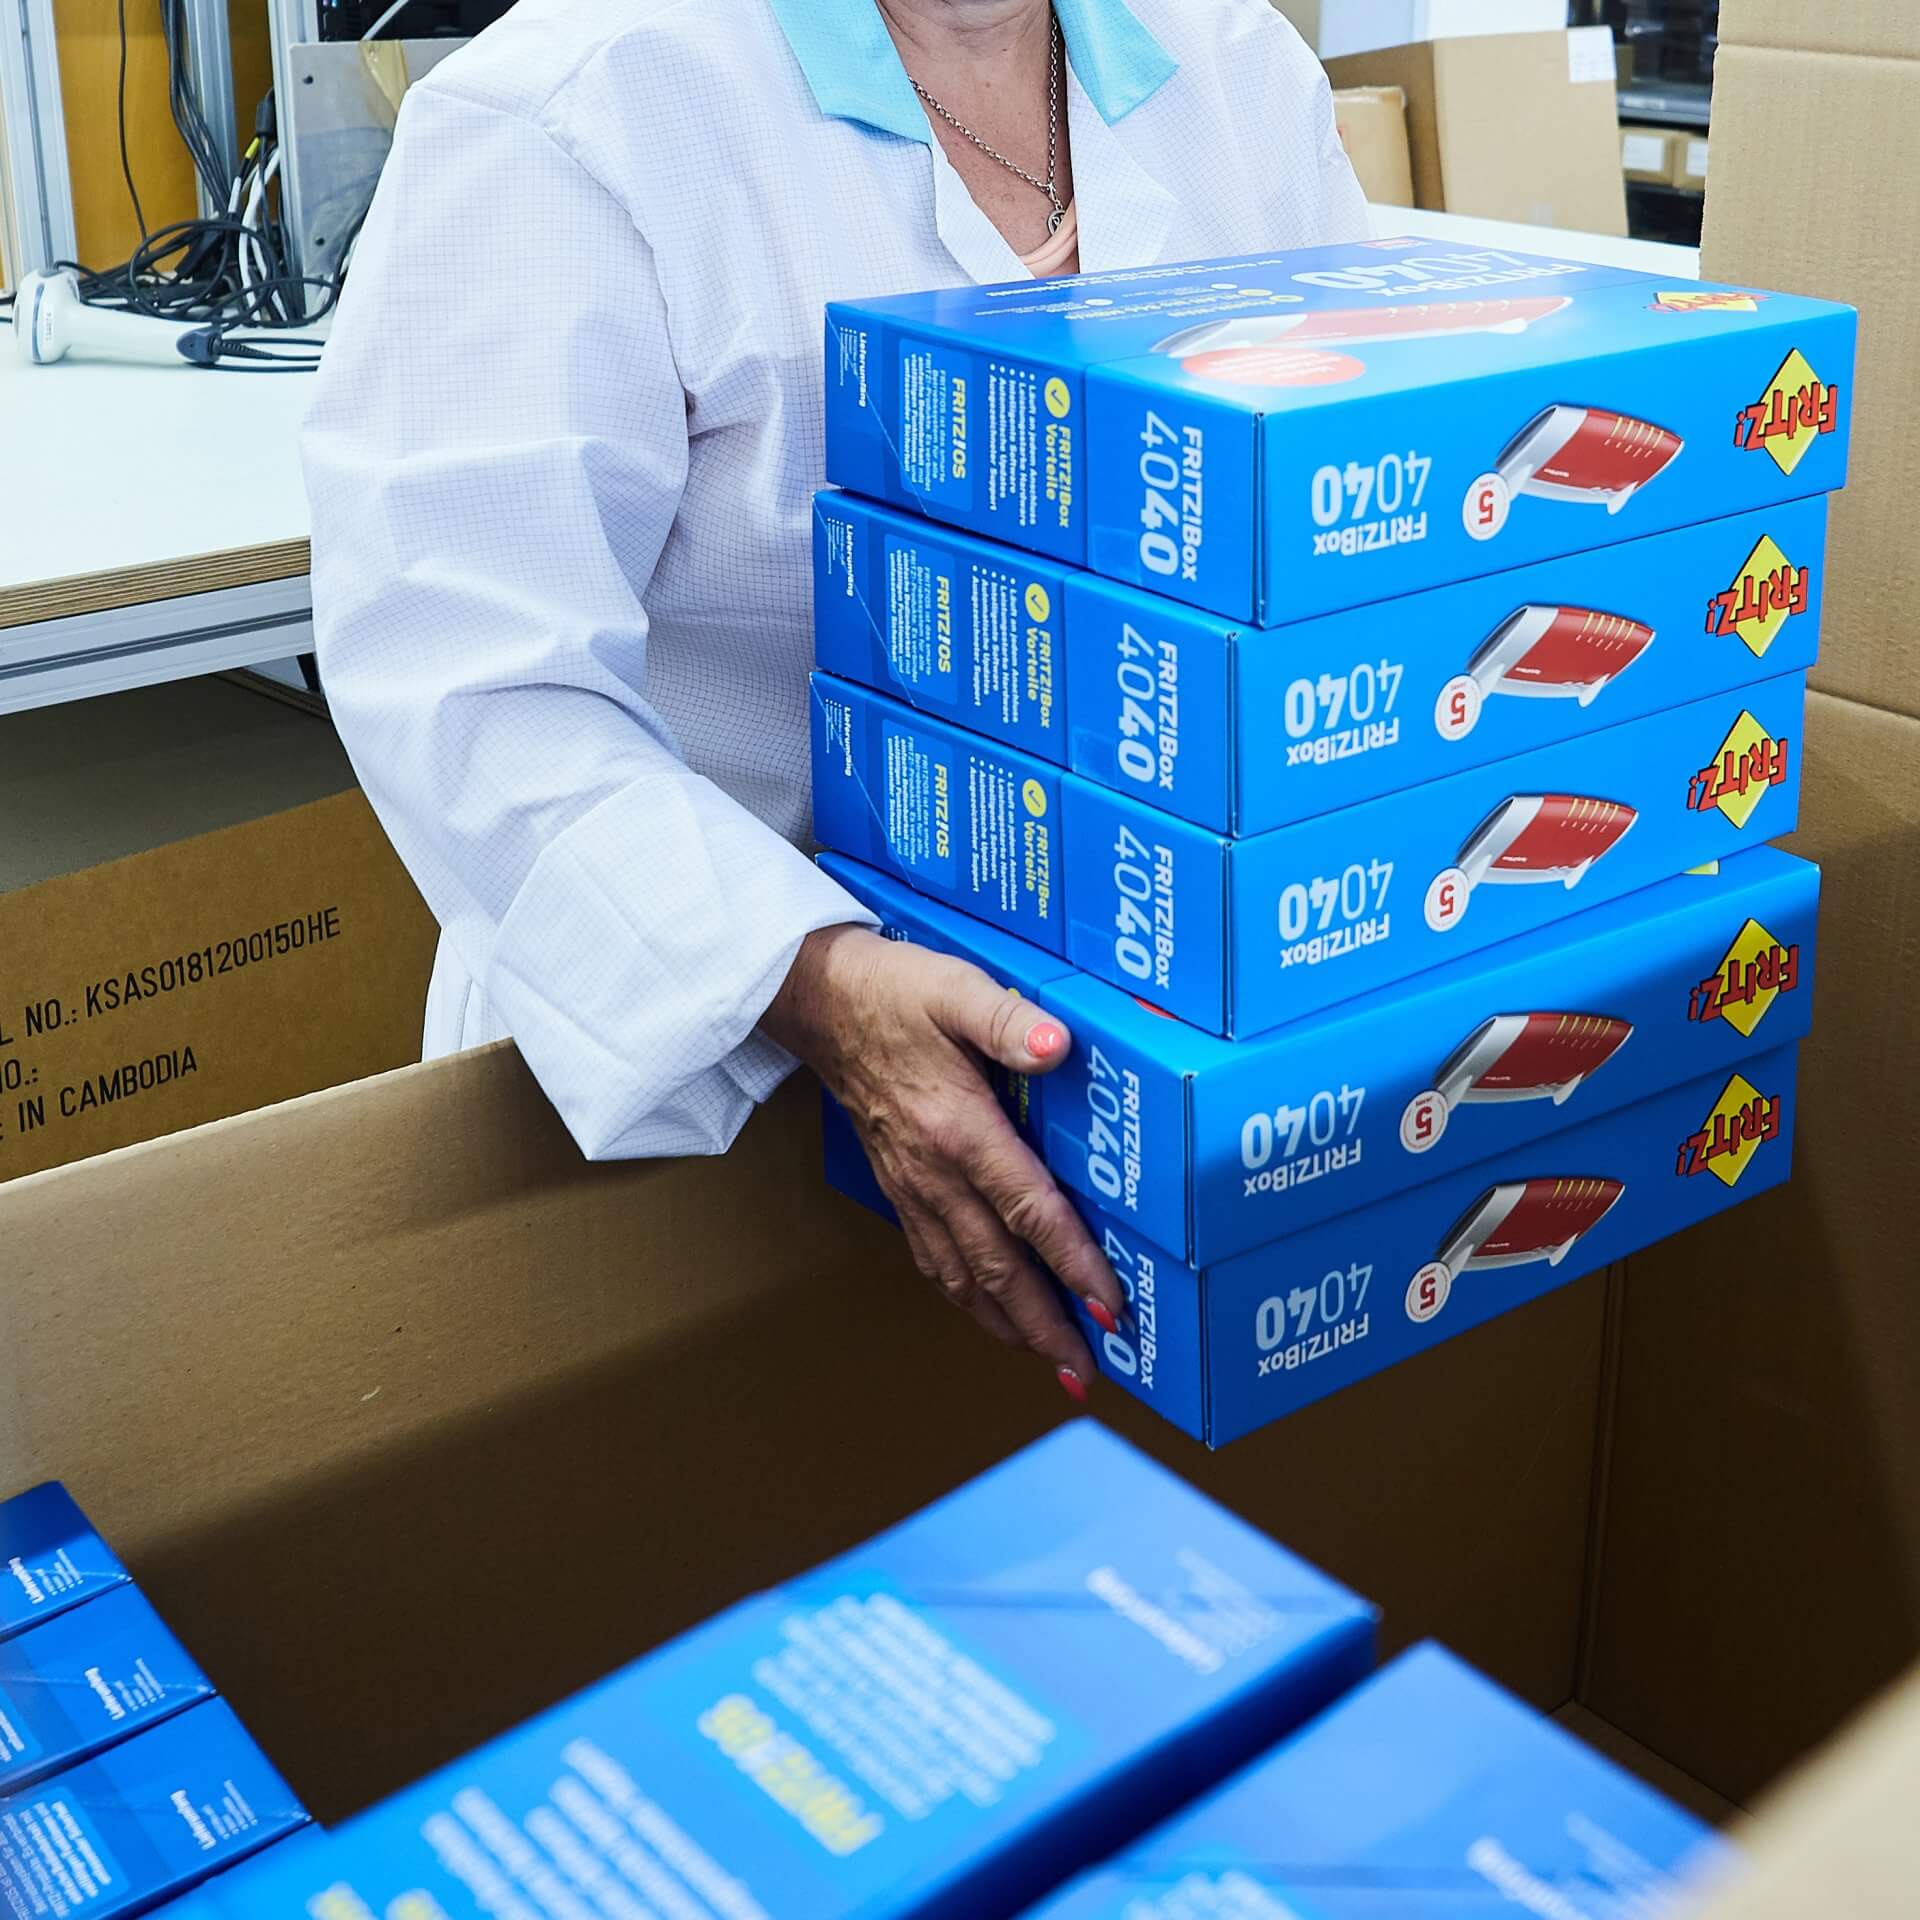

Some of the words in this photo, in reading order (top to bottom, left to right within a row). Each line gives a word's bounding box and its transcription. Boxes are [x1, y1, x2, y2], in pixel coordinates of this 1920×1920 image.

[1290, 251, 1528, 290] 4040
[1366, 263, 1587, 296] FRITZ!Box
[952, 376, 965, 480] FRITZ!OS
[988, 374, 996, 465] Ausgezeichneter
[1027, 430, 1035, 466] jedem
[1733, 381, 1838, 452] FRITZ!
[988, 467, 996, 511] Support
[998, 453, 1006, 499] Updates
[1045, 422, 1057, 501] Vorteile
[1058, 425, 1071, 529] FRITZ!Box
[1140, 410, 1180, 576] 4040
[1311, 449, 1432, 527] 4040
[1182, 425, 1203, 583] FRITZ!Box
[1312, 511, 1427, 556] FRITZ!Box
[1478, 490, 1494, 525] 5
[936, 574, 950, 674] FRITZ!OS
[970, 575, 979, 663] Ausgezeichneter
[989, 581, 998, 642] Intelligente
[1705, 565, 1809, 637] FRITZ!
[972, 663, 980, 706] Support
[982, 651, 990, 696] Updates
[1009, 632, 1017, 667] jedem
[1026, 625, 1038, 702] Vorteile
[1038, 629, 1052, 729] FRITZ!Box
[1011, 667, 1019, 723] Anschluss
[1117, 622, 1156, 783] 4040
[1157, 639, 1178, 791] FRITZ!Box
[1284, 658, 1404, 738] 4040
[1450, 692, 1466, 726] 5
[1286, 716, 1399, 767] FRITZ!Box
[1686, 738, 1788, 812] FRITZ!
[934, 762, 948, 860] FRITZ!OS
[970, 851, 979, 892] Support
[980, 839, 988, 883] Updates
[989, 833, 997, 880] Software
[1023, 818, 1036, 893] Vorteile
[1036, 823, 1049, 920] FRITZ!Box
[1113, 824, 1152, 980] 4040
[1154, 844, 1174, 990] FRITZ!Box
[1278, 857, 1394, 941] 4040
[1439, 884, 1454, 918] 5
[25, 998, 77, 1038] NO.:
[84, 906, 341, 1019] KSAS0181200150HE
[1280, 912, 1390, 969] FRITZ!Box
[1687, 944, 1799, 1023] FRITZ!
[0, 1058, 38, 1094] O.:
[18, 1096, 46, 1133] IN
[59, 1046, 197, 1117] CAMBODIA
[1087, 1044, 1122, 1199] 4040
[1122, 1068, 1141, 1212] FRITZ!Box
[1241, 1083, 1366, 1170] 4040
[1415, 1105, 1433, 1141] 5
[1675, 1094, 1780, 1177] FRITZ!
[1244, 1138, 1361, 1198] FRITZ!Box
[1103, 1227, 1137, 1376] 40
[1137, 1252, 1157, 1391] FRITZ!Box
[1256, 1262, 1373, 1351] 4040
[1420, 1276, 1436, 1310] 5
[1258, 1312, 1369, 1377] FRITZ!Box
